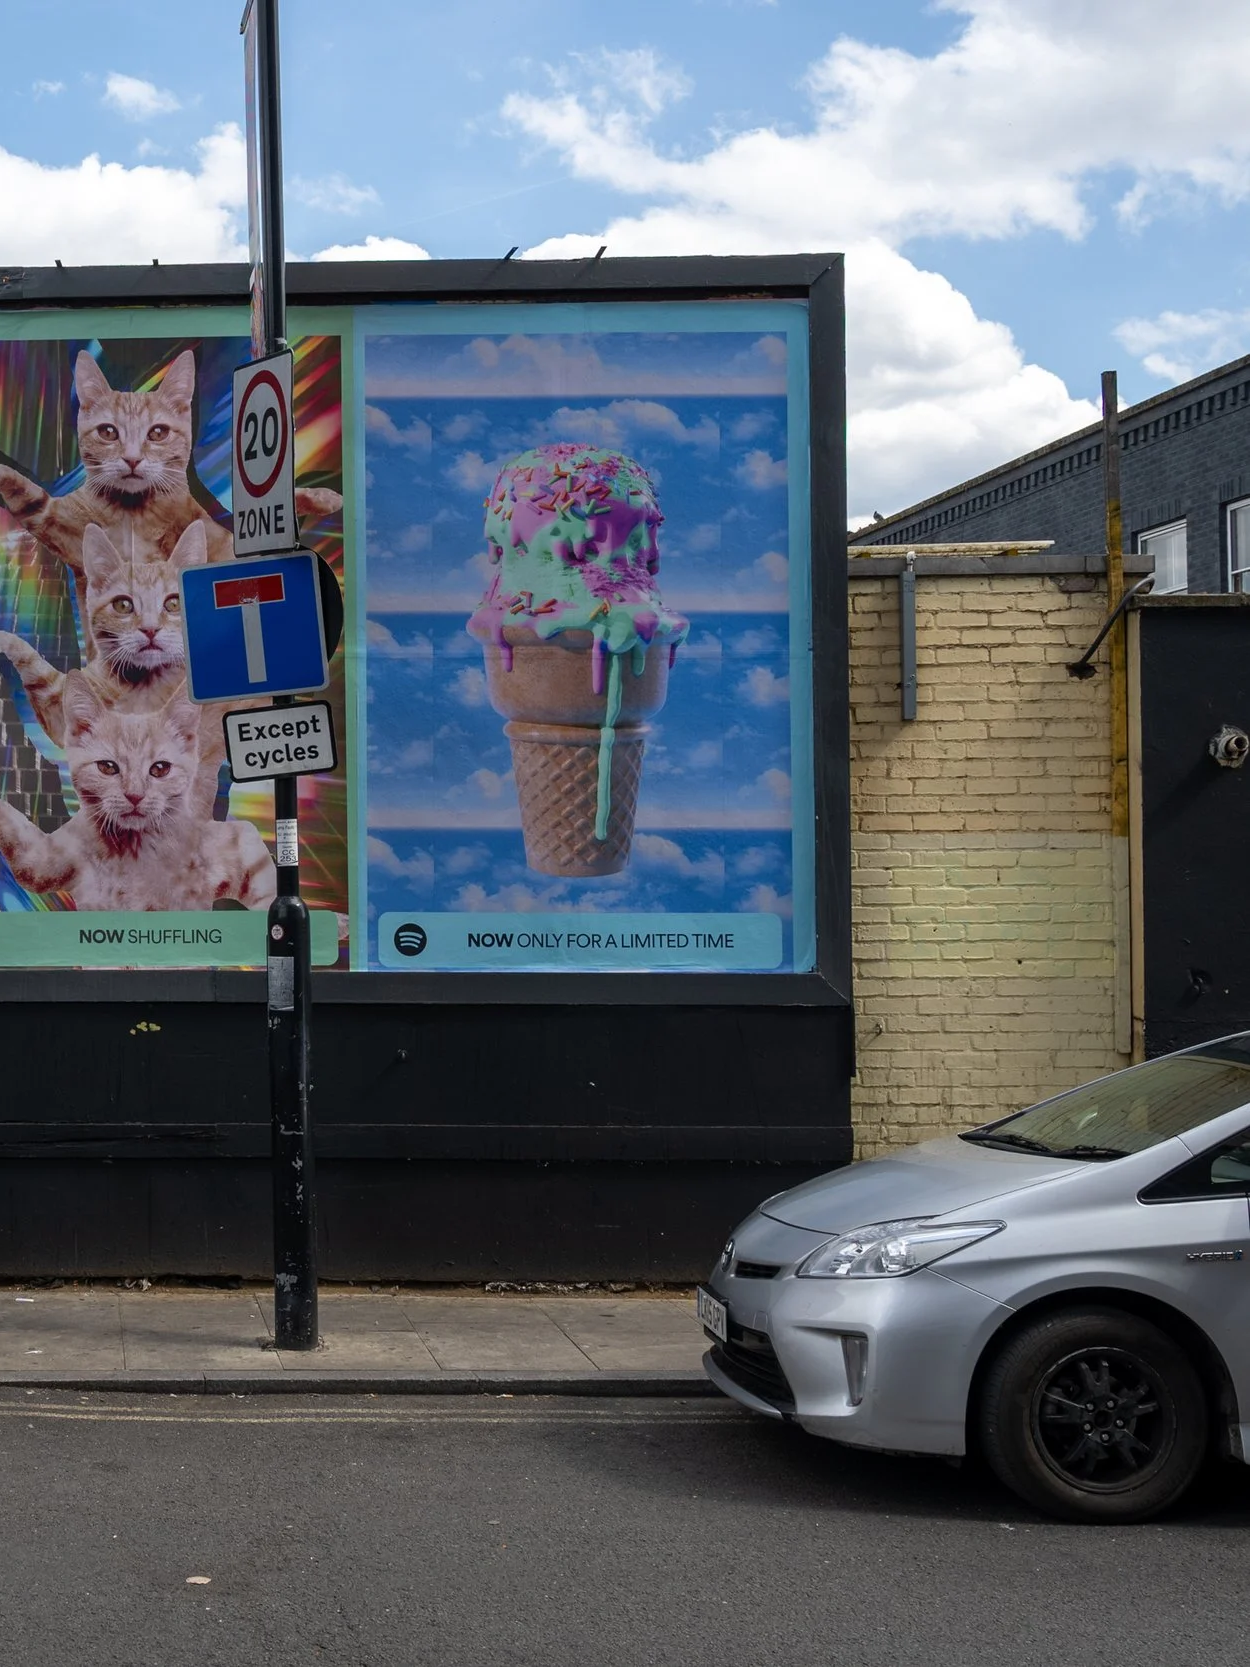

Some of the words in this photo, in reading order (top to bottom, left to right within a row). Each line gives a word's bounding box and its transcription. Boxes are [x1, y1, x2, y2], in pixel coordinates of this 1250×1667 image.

[243, 406, 279, 462] 20
[238, 503, 286, 540] ZONE
[237, 714, 321, 742] Except
[244, 742, 320, 769] cycles
[79, 929, 125, 944] NOW
[128, 929, 222, 944] SHUFFLING
[467, 933, 514, 948] NOW
[517, 933, 563, 948] ONLY
[567, 933, 601, 948] FOR
[605, 933, 618, 948] A
[621, 933, 689, 948] LIMITED
[691, 933, 735, 948] TIME
